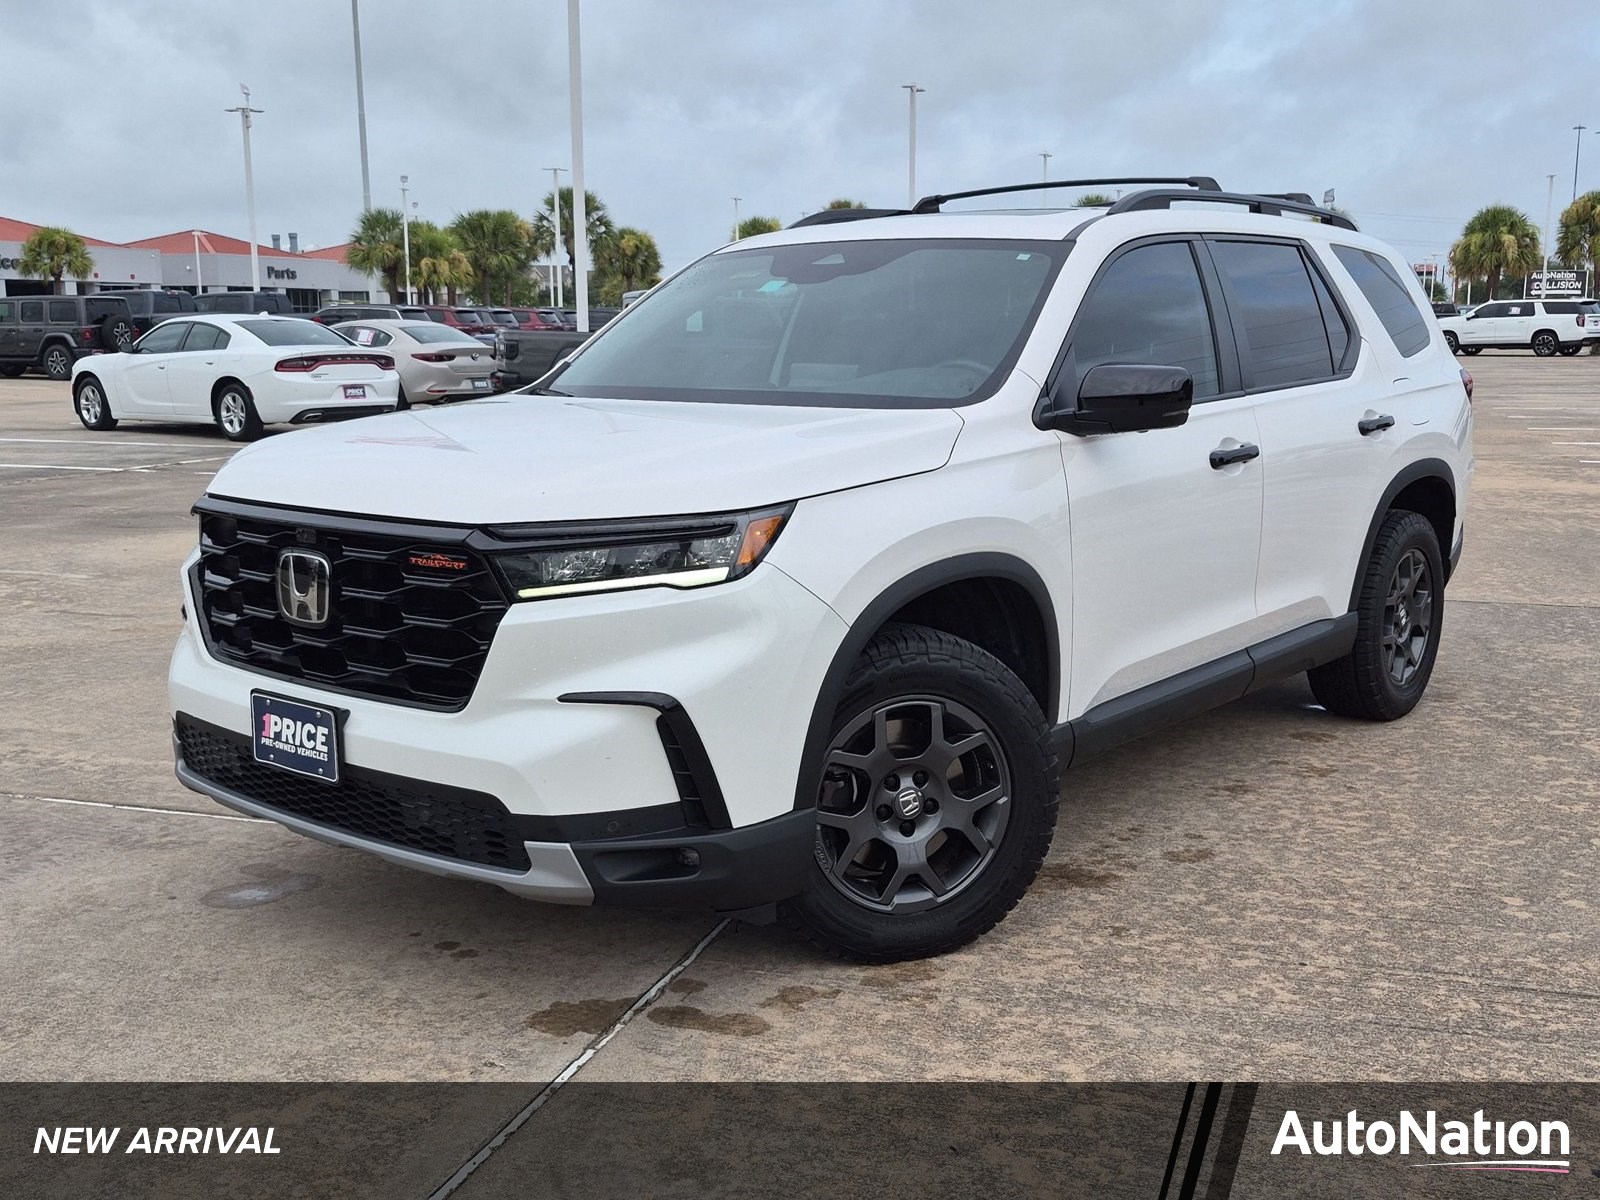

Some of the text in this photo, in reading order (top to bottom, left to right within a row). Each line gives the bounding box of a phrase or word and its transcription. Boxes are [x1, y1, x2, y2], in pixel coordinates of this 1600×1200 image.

[267, 266, 297, 280] Parts
[1531, 271, 1577, 280] AuoNation
[409, 556, 466, 569] TRAILSPORT
[261, 737, 329, 762] PRE-OWNED VEHICLES
